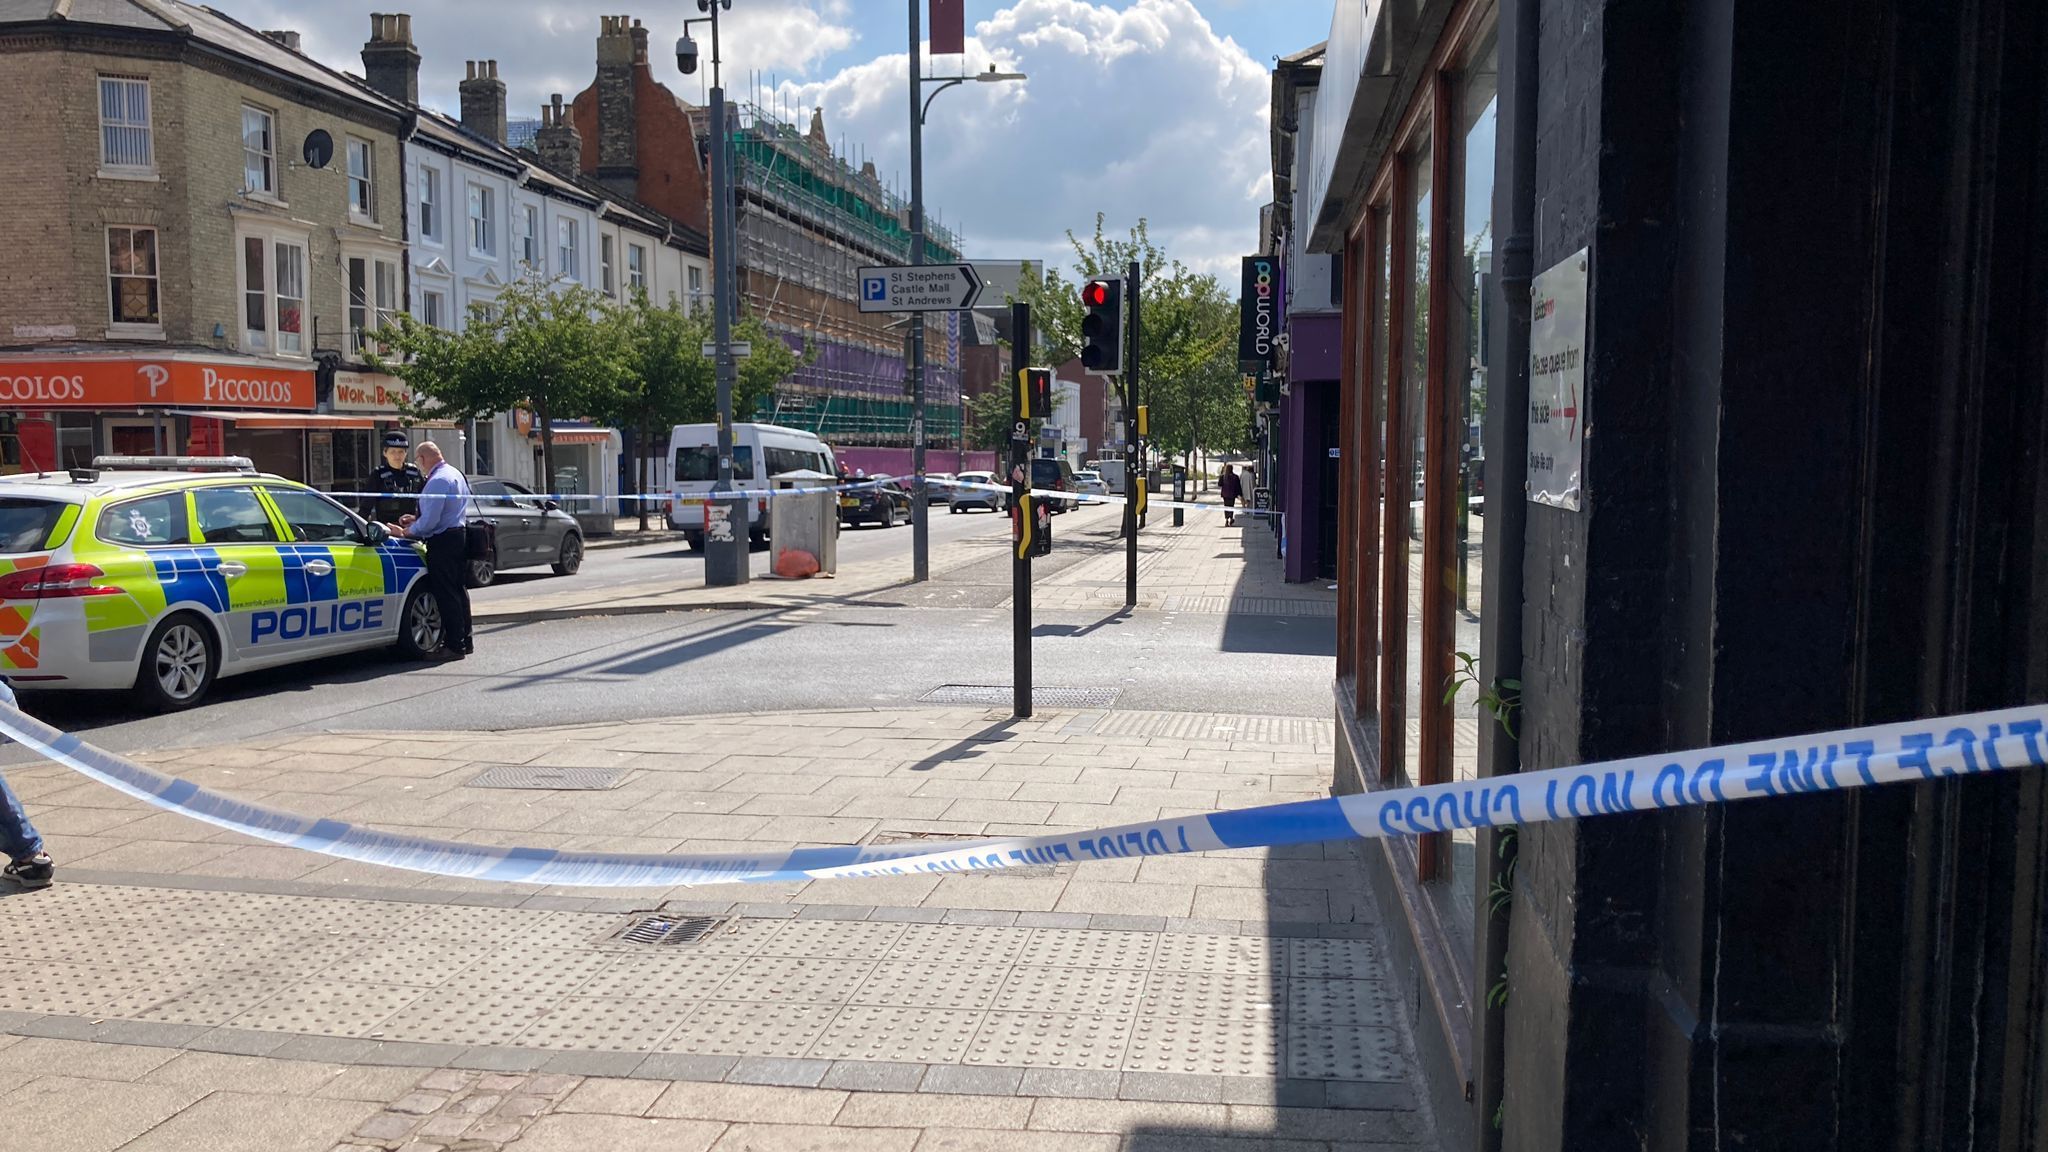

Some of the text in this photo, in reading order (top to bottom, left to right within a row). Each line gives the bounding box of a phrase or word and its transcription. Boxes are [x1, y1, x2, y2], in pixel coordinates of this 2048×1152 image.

[891, 271, 956, 283] St Stephens
[867, 279, 883, 300] P
[891, 284, 950, 294] Castle Mall
[891, 296, 952, 306] St Andrews
[1532, 344, 1580, 379] Please queue from
[1531, 399, 1550, 424] this side
[1015, 421, 1026, 435] 9
[1129, 418, 1136, 428] 7
[339, 587, 349, 597] Our
[349, 587, 368, 597] Priority
[374, 585, 384, 594] You
[250, 598, 384, 644] POLICE
[1896, 718, 2048, 780] LICE
[1748, 740, 1878, 797] LINE
